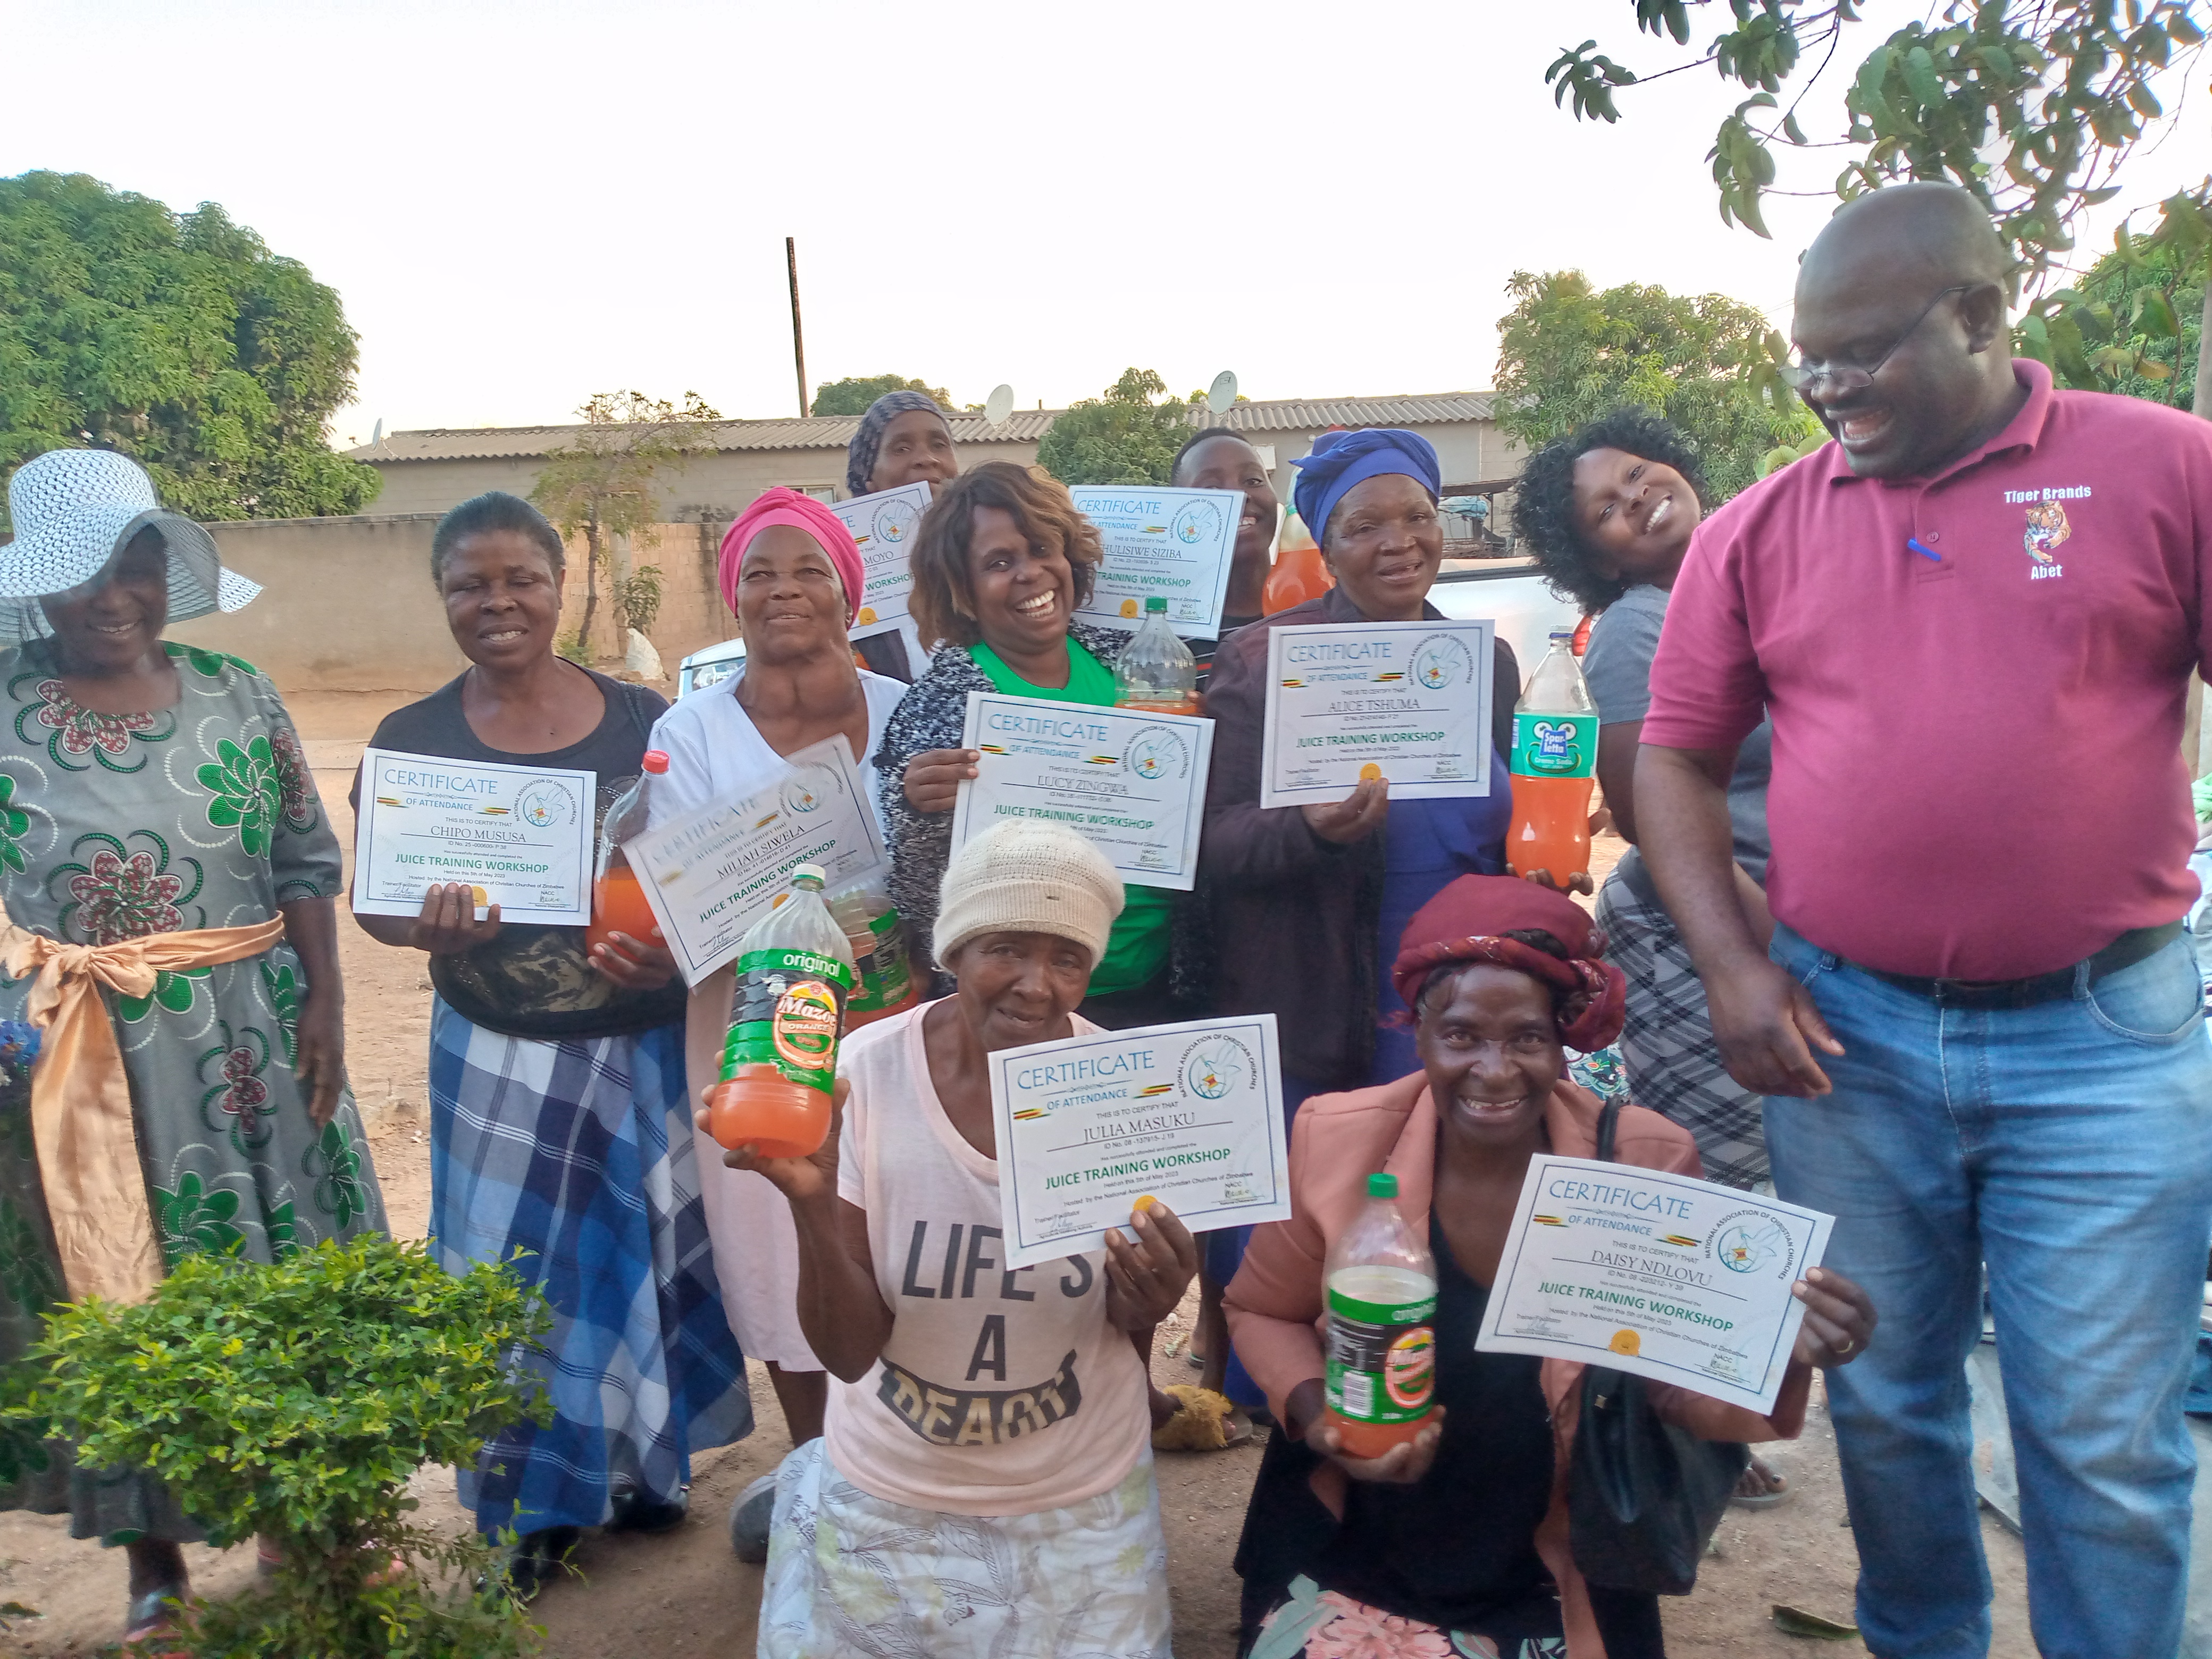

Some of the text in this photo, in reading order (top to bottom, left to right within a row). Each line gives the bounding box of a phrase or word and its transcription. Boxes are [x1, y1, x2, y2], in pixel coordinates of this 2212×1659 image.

[2004, 485, 2092, 503] Tiger Brands
[871, 500, 890, 523] ASSOCIATION
[896, 499, 917, 512] CHRISTIAN
[1077, 499, 1161, 514] CERTIFICATE
[1175, 499, 1200, 517] ASSOCIATION
[1207, 501, 1221, 518] CHRISTIAN
[871, 523, 881, 544] NATIONAL
[1213, 518, 1222, 542] CHURCHES
[864, 550, 894, 565] MOYO
[1151, 548, 1183, 558] SIZIBA
[1095, 572, 1191, 587] TRAINING WORKSHOP
[2031, 564, 2063, 580] Abet
[1286, 642, 1392, 662] CERTIFICATE
[1328, 698, 1421, 713] ALICE TSHUMA
[987, 713, 1109, 741] CERTIFICATE
[1545, 732, 1565, 744] Spar-
[1296, 731, 1445, 748] JUICE TRAINING WORKSHOP
[1544, 743, 1564, 753] letta
[384, 768, 498, 794] CERTIFICATE
[517, 778, 544, 797] ASSOCIATION
[554, 781, 575, 800] CHRISTIAN
[1036, 775, 1073, 789] LUCY
[419, 799, 473, 810] ATTENDANCE
[993, 804, 1154, 831] JUICE TRAINING WORKSHOP
[430, 825, 526, 843] CHIPO MUSUSA
[759, 823, 805, 854] SIWELA
[395, 853, 549, 874] JUICE TRAINING WORKSHOP
[698, 900, 727, 923] JUICE
[726, 870, 777, 906] TRAINING
[777, 837, 837, 876] WORKSHOP
[718, 917, 733, 928] Hosted
[747, 898, 766, 910] National
[783, 952, 840, 977] original
[1179, 1035, 1212, 1065] ASSOCIATION
[1016, 1050, 1155, 1090] CERTIFICATE
[1177, 1065, 1187, 1097] NATIONAL
[1047, 1088, 1128, 1110] OF ATTENDANCE
[1133, 1104, 1160, 1114] CERTIFY
[1083, 1122, 1125, 1143] JULIA
[1129, 1111, 1196, 1134] MASUKU
[1044, 1171, 1080, 1190] JUICE
[1084, 1160, 1149, 1182] TRAINING
[1152, 1146, 1231, 1171] WORKSHOP
[1549, 1179, 1694, 1220] CERTIFICATE
[1567, 1213, 1653, 1238] OF ATTENDANCE
[1713, 1210, 1758, 1228] ASSOCIATION
[1770, 1216, 1793, 1248] CHRISTIAN
[1611, 1240, 1629, 1249] THIS
[1649, 1248, 1679, 1260] CERTIFY
[1680, 1254, 1699, 1264] THAT
[1705, 1228, 1717, 1259] NATIONAL
[1590, 1249, 1639, 1271] DAISY
[1639, 1259, 1713, 1286] NDLOVU
[1778, 1247, 1795, 1280] CHURCHES
[1537, 1279, 1575, 1298] JUICE
[1577, 1285, 1646, 1311] TRAINING
[1646, 1301, 1736, 1333] WORKSHOP
[965, 1314, 1007, 1381] A
